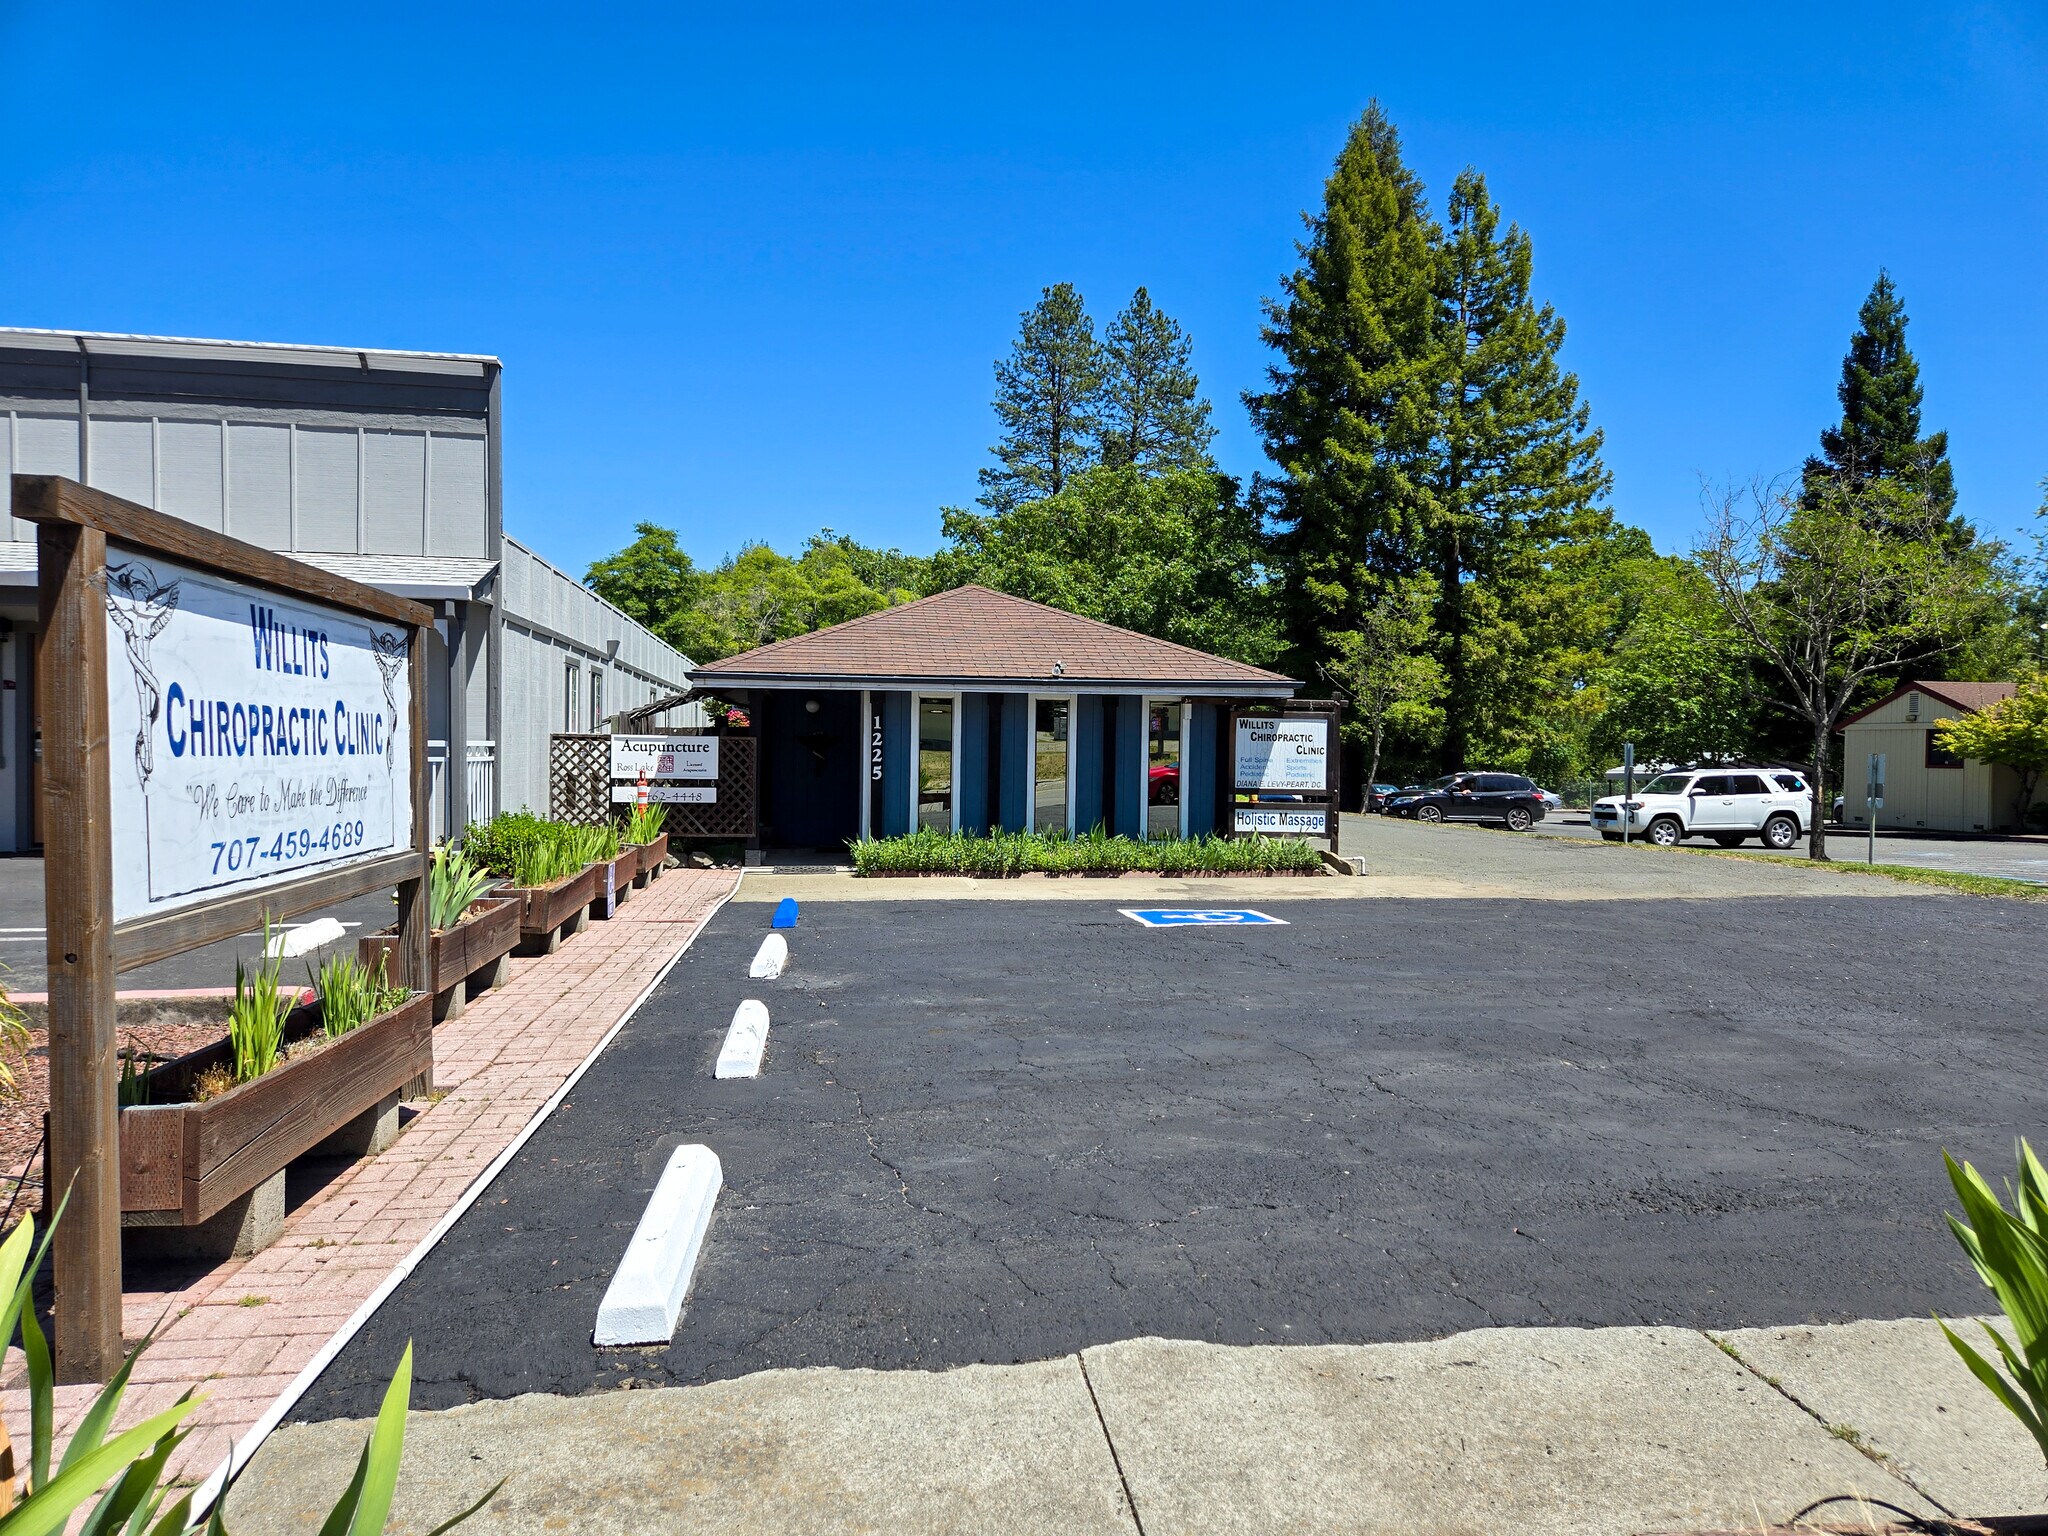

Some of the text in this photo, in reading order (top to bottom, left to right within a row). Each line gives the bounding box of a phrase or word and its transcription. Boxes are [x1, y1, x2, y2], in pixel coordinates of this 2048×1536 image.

[250, 603, 329, 680] WILLITS
[166, 681, 383, 758] CHIROPRACTIC CLINIC
[1239, 719, 1275, 730] WILLITS
[1250, 732, 1314, 743] CHIROPRACTIC
[620, 739, 710, 756] Acupuncture
[872, 715, 883, 780] 1225
[1296, 745, 1325, 756] CLINIC
[616, 762, 634, 772] Ross
[1236, 780, 1258, 788] DIANA
[226, 782, 255, 818] Care
[260, 785, 270, 812] to
[274, 778, 306, 813] Make
[310, 779, 323, 807] the
[1236, 812, 1325, 829] Holistic Massage
[211, 820, 364, 875] 707-459-4689
